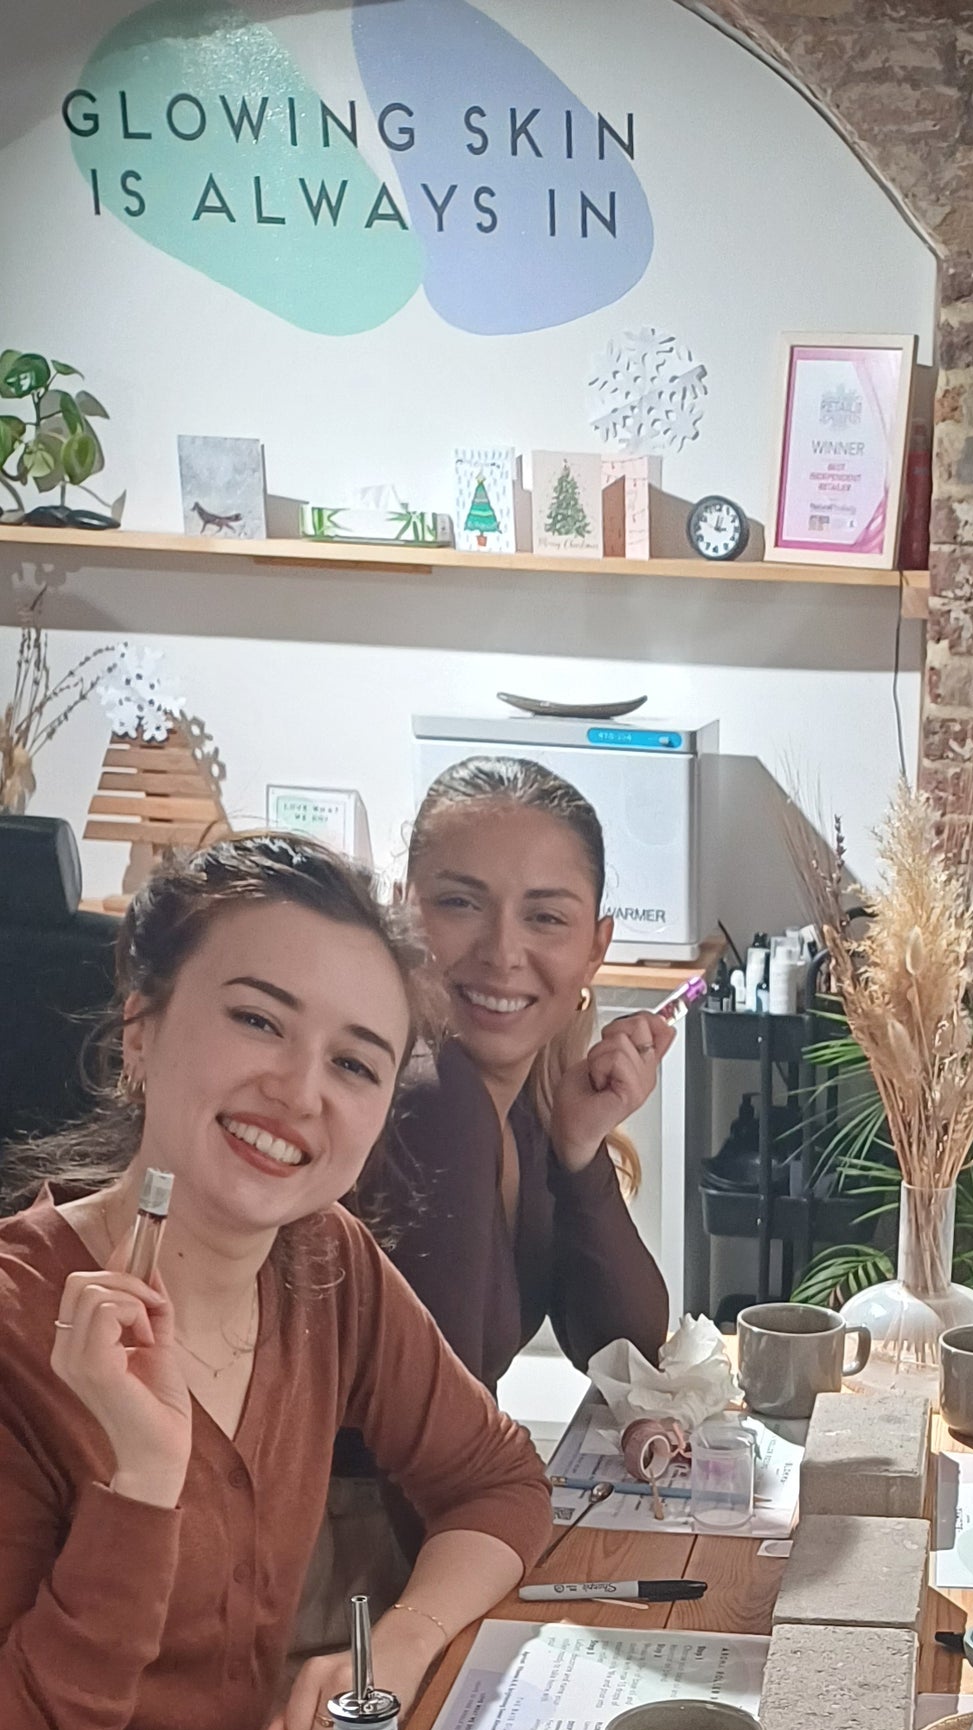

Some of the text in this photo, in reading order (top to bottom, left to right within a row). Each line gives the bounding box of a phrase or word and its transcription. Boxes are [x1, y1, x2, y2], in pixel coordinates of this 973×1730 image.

[61, 89, 638, 160] GLOWING SKIN
[91, 169, 618, 239] IS ALWAYS IN
[811, 440, 865, 456] WINNER
[607, 906, 666, 922] WARMER
[581, 1583, 617, 1594] Sharpie
